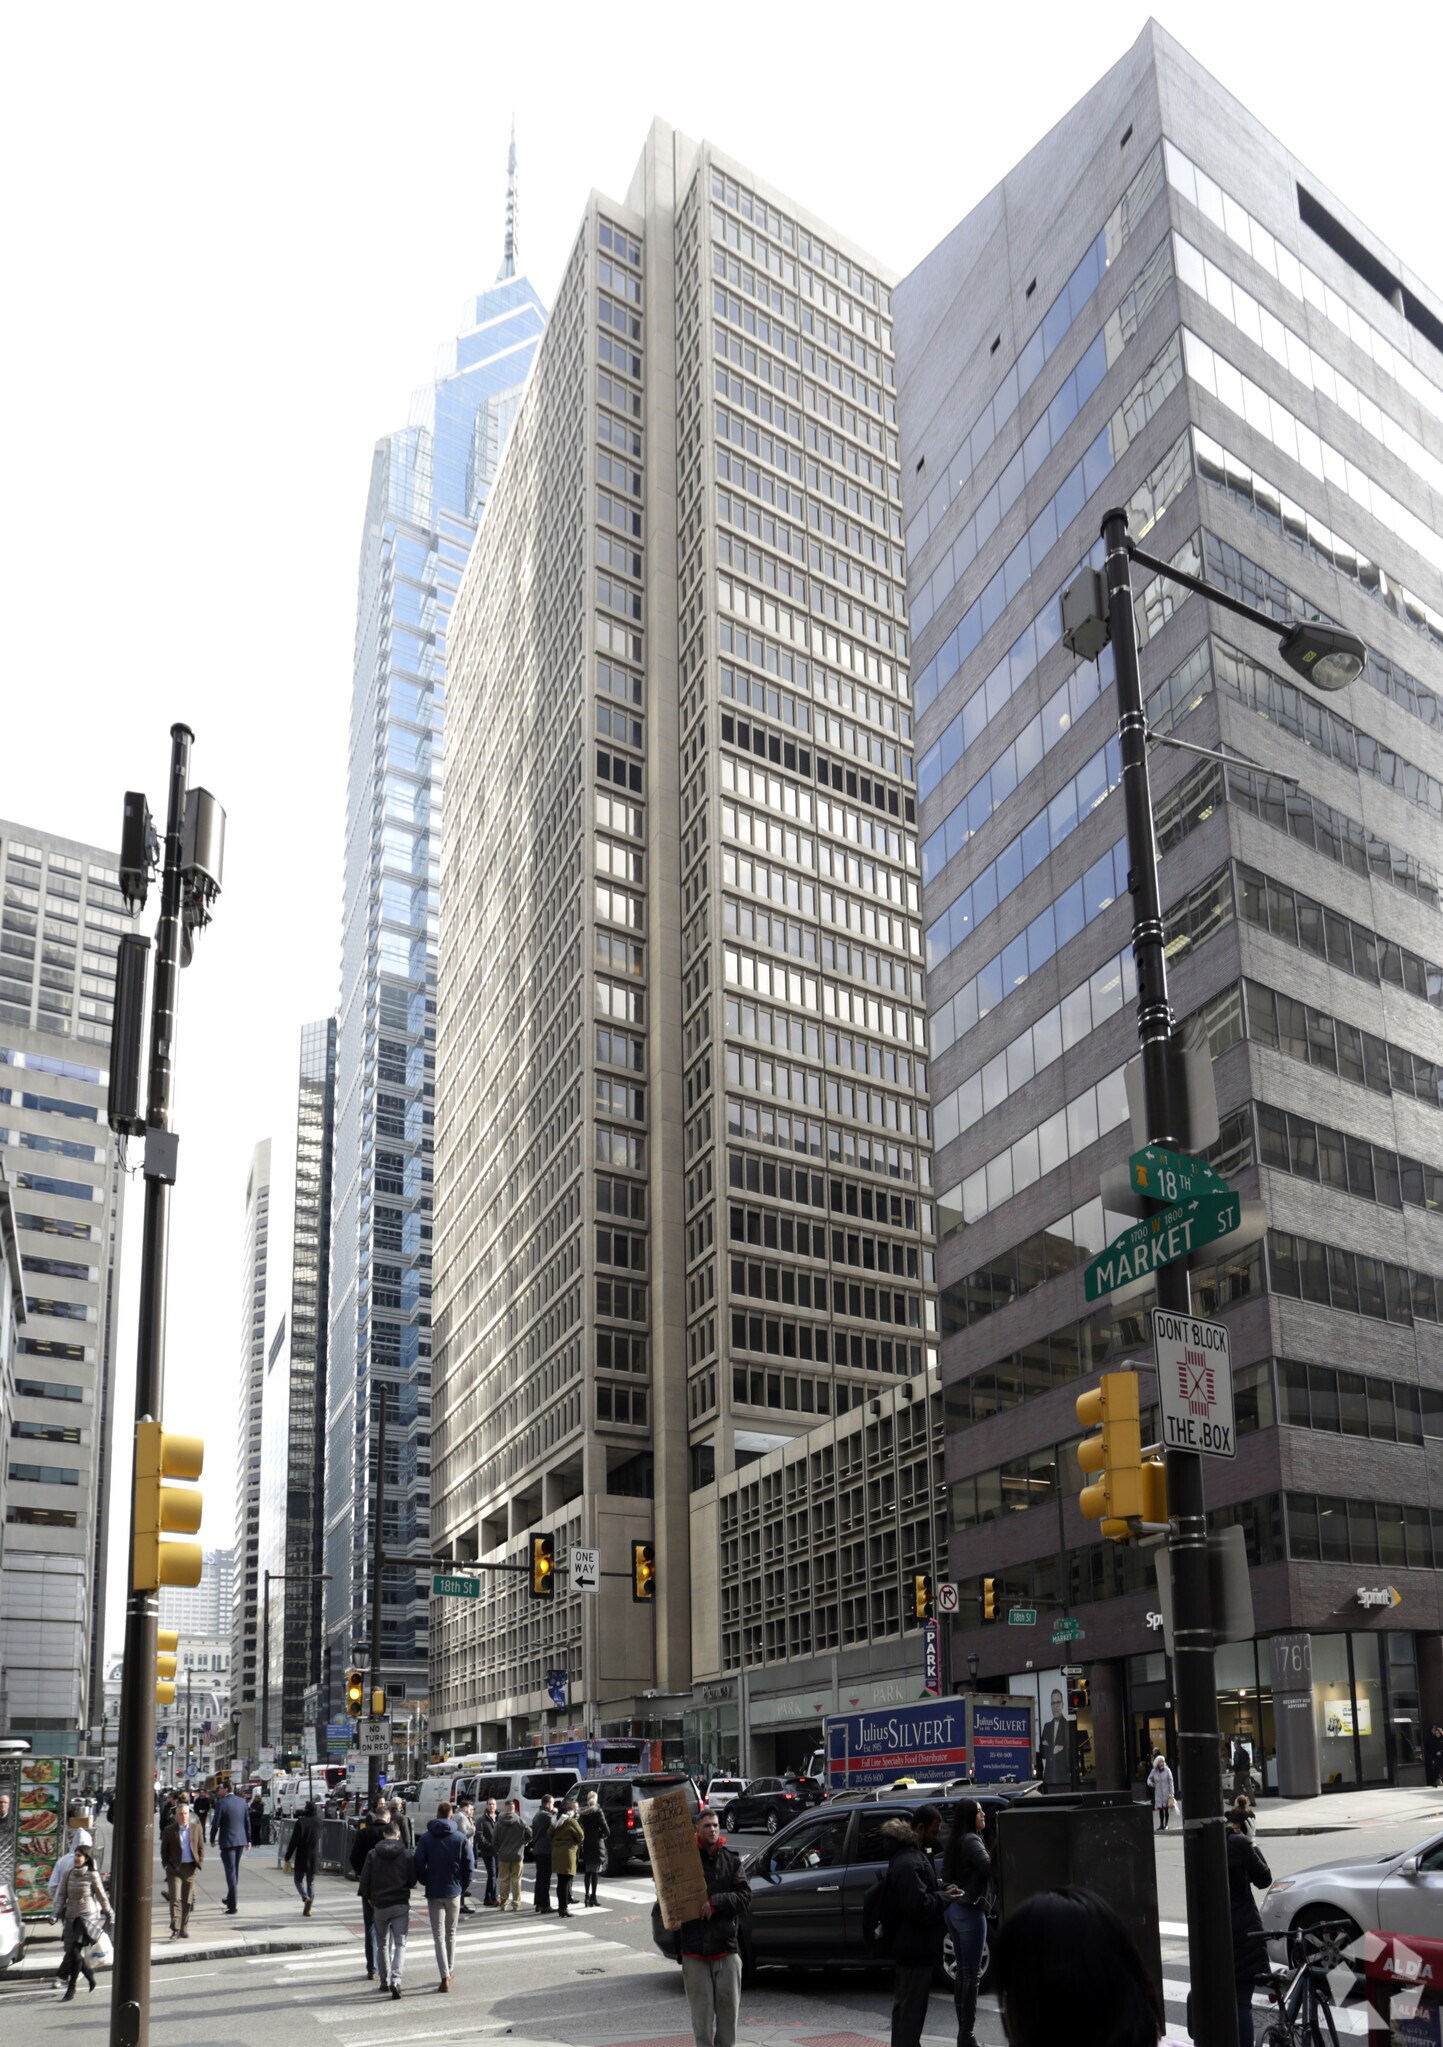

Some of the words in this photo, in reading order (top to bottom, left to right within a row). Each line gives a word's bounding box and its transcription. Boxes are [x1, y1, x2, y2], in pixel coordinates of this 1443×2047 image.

[1131, 1226, 1148, 1243] 1700
[1152, 1217, 1160, 1233] W
[1164, 1208, 1183, 1224] 1800
[1096, 1218, 1194, 1294] MARKET
[1217, 1206, 1234, 1233] ST
[1193, 1324, 1227, 1353] BLOCK
[1167, 1416, 1197, 1445] THE
[1203, 1422, 1231, 1452] BOX
[576, 1552, 594, 1562] ONE
[575, 1564, 594, 1574] WAY
[440, 1580, 460, 1593] 18th
[463, 1582, 472, 1594] St
[1357, 1587, 1390, 1608] Sprint
[1013, 1612, 1025, 1623] 18th
[1026, 1612, 1032, 1623] St
[1052, 1633, 1072, 1644] MARKET
[926, 1632, 936, 1678] PARK
[873, 1685, 904, 1703] PARK
[777, 1702, 802, 1716] PARK
[369, 1724, 380, 1733] NO
[974, 1714, 993, 1728] Julius
[993, 1716, 1027, 1732] SILVERT
[84, 1731, 91, 1740] P
[365, 1734, 386, 1742] TURN
[855, 1718, 888, 1750] Julius
[888, 1718, 955, 1748] SILVERT
[861, 1759, 870, 1767] Full
[871, 1758, 881, 1766] Line
[882, 1756, 904, 1767] Specialty
[904, 1755, 917, 1764] Food
[918, 1754, 947, 1763] Distributor
[856, 1773, 884, 1782] 215-455-1600
[1383, 1957, 1403, 1974] AL
